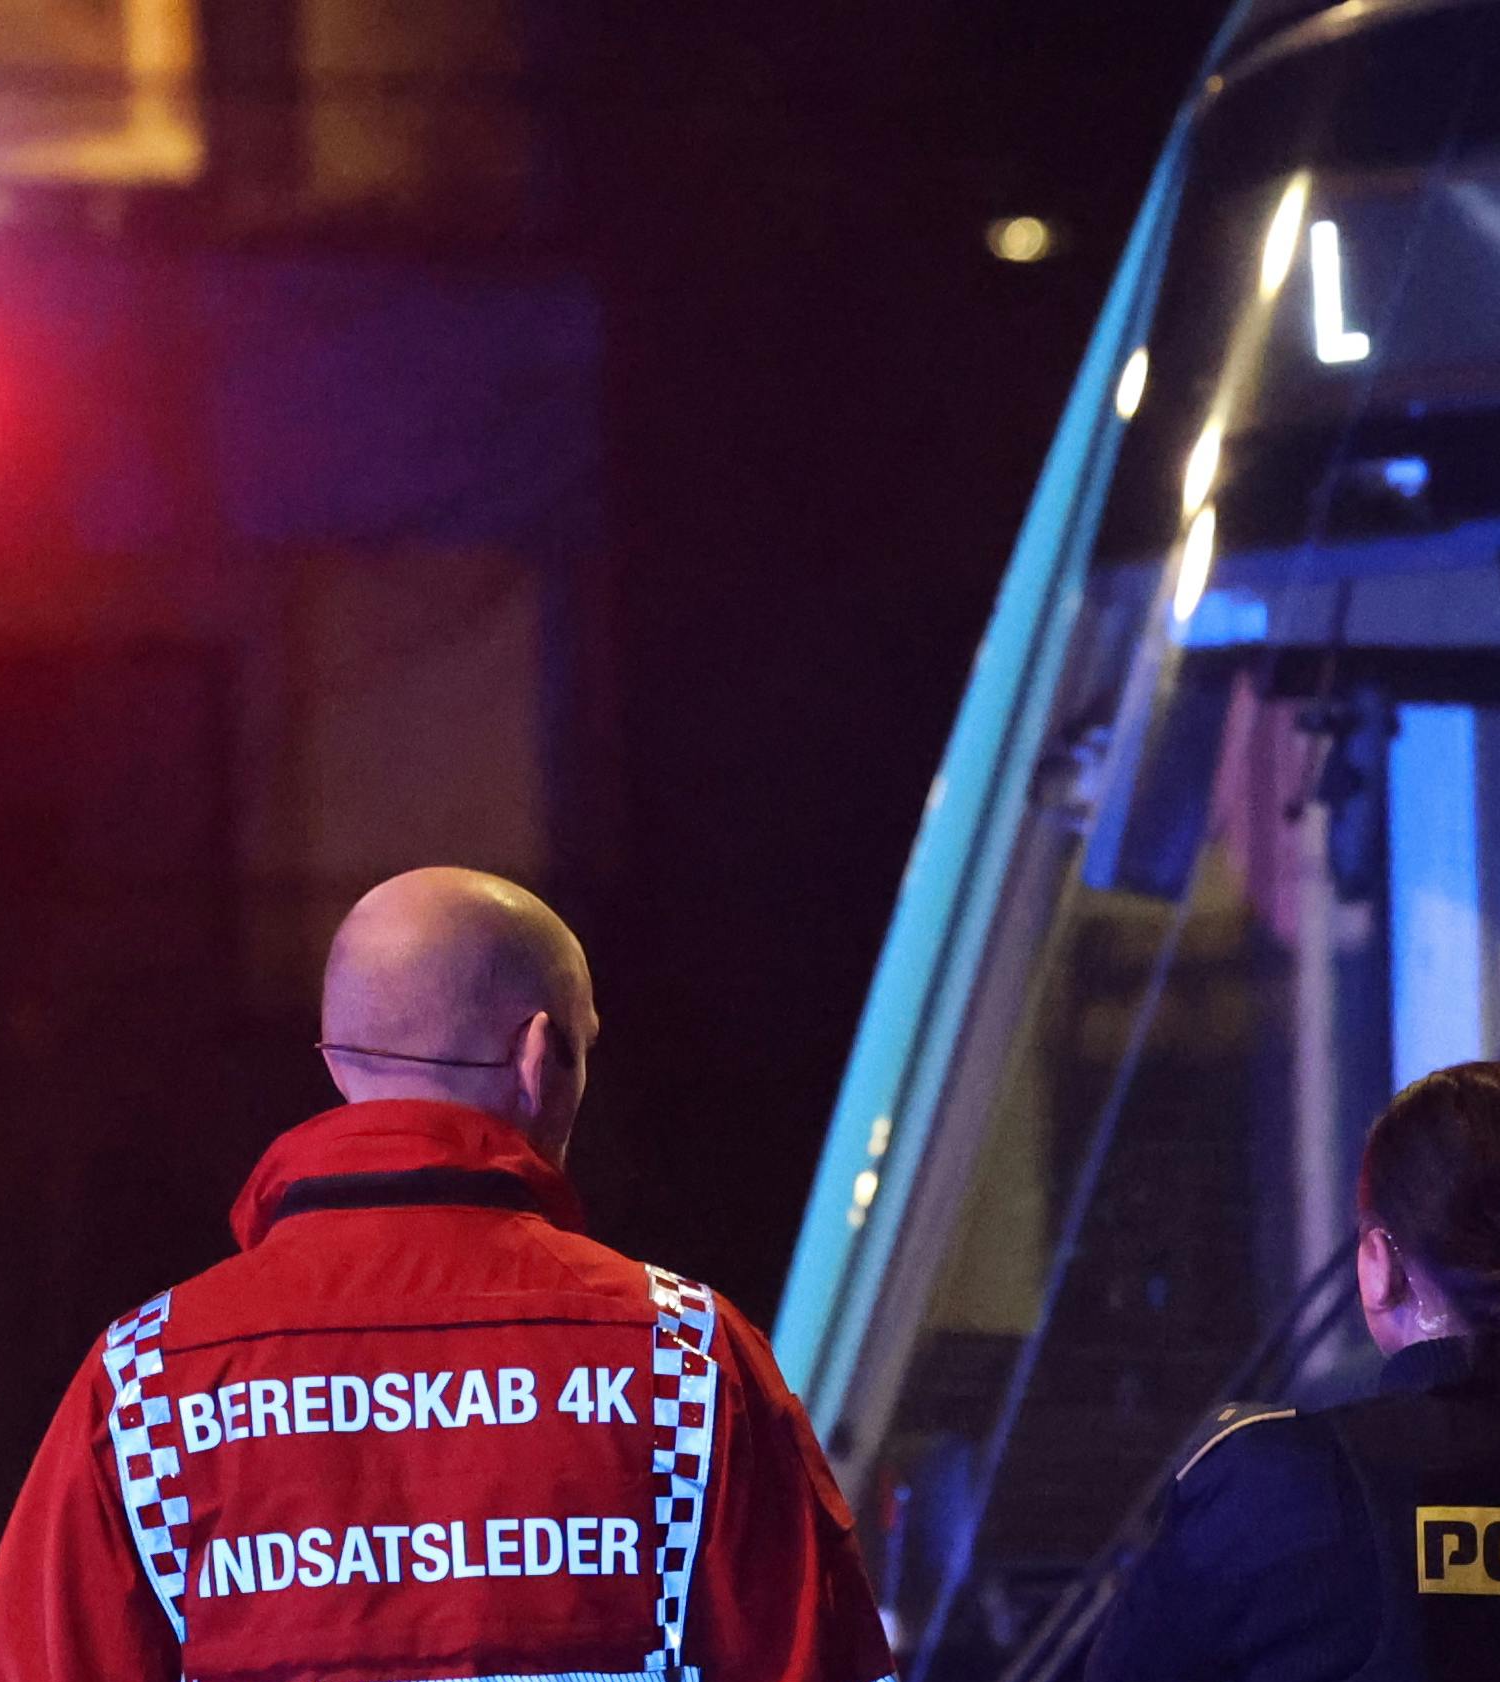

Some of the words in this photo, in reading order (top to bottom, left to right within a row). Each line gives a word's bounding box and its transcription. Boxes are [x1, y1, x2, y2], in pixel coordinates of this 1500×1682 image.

[178, 1366, 540, 1455] BEREDSKAB
[557, 1365, 639, 1427] 4K
[198, 1515, 640, 1599] INDSATSLEDER
